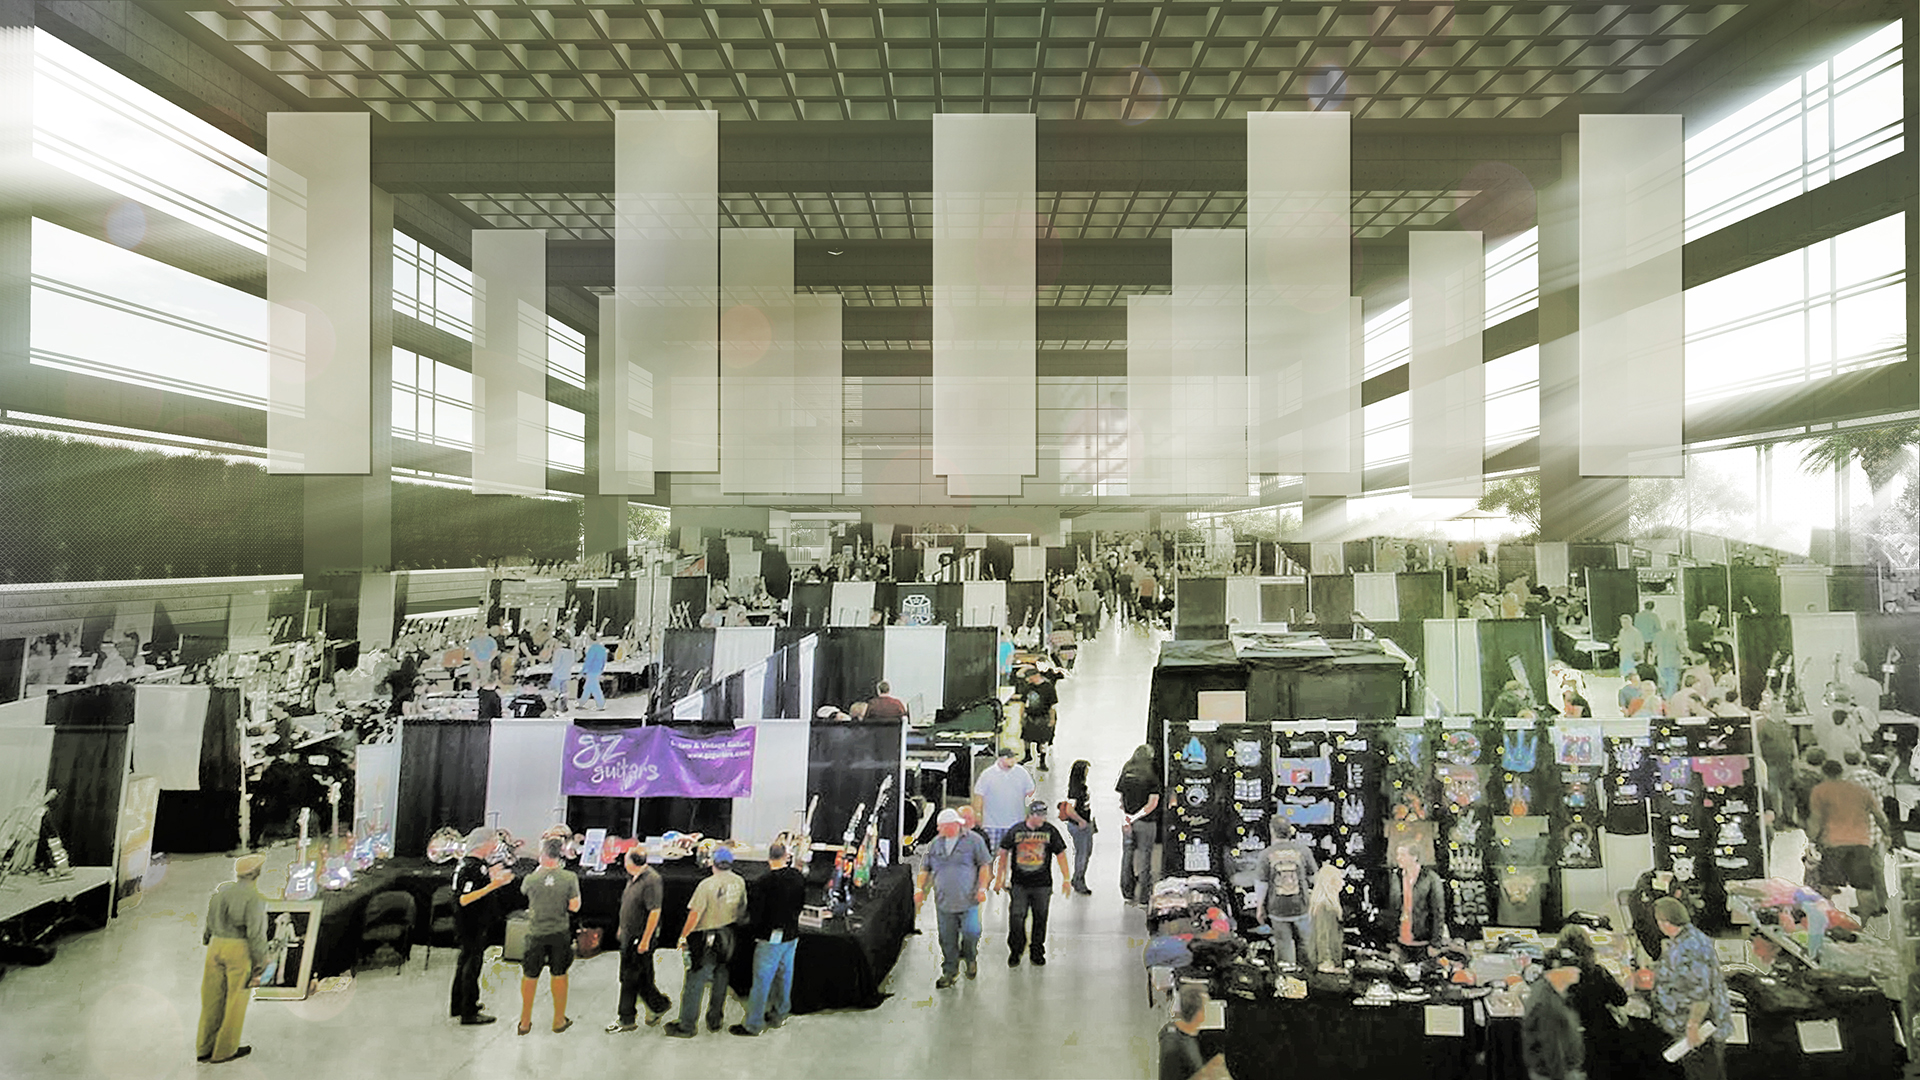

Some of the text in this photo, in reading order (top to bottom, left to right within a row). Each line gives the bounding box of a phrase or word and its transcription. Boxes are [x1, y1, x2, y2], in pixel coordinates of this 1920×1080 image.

[701, 741, 726, 750] Vintage
[727, 740, 751, 749] Guitars
[591, 755, 660, 784] guitars
